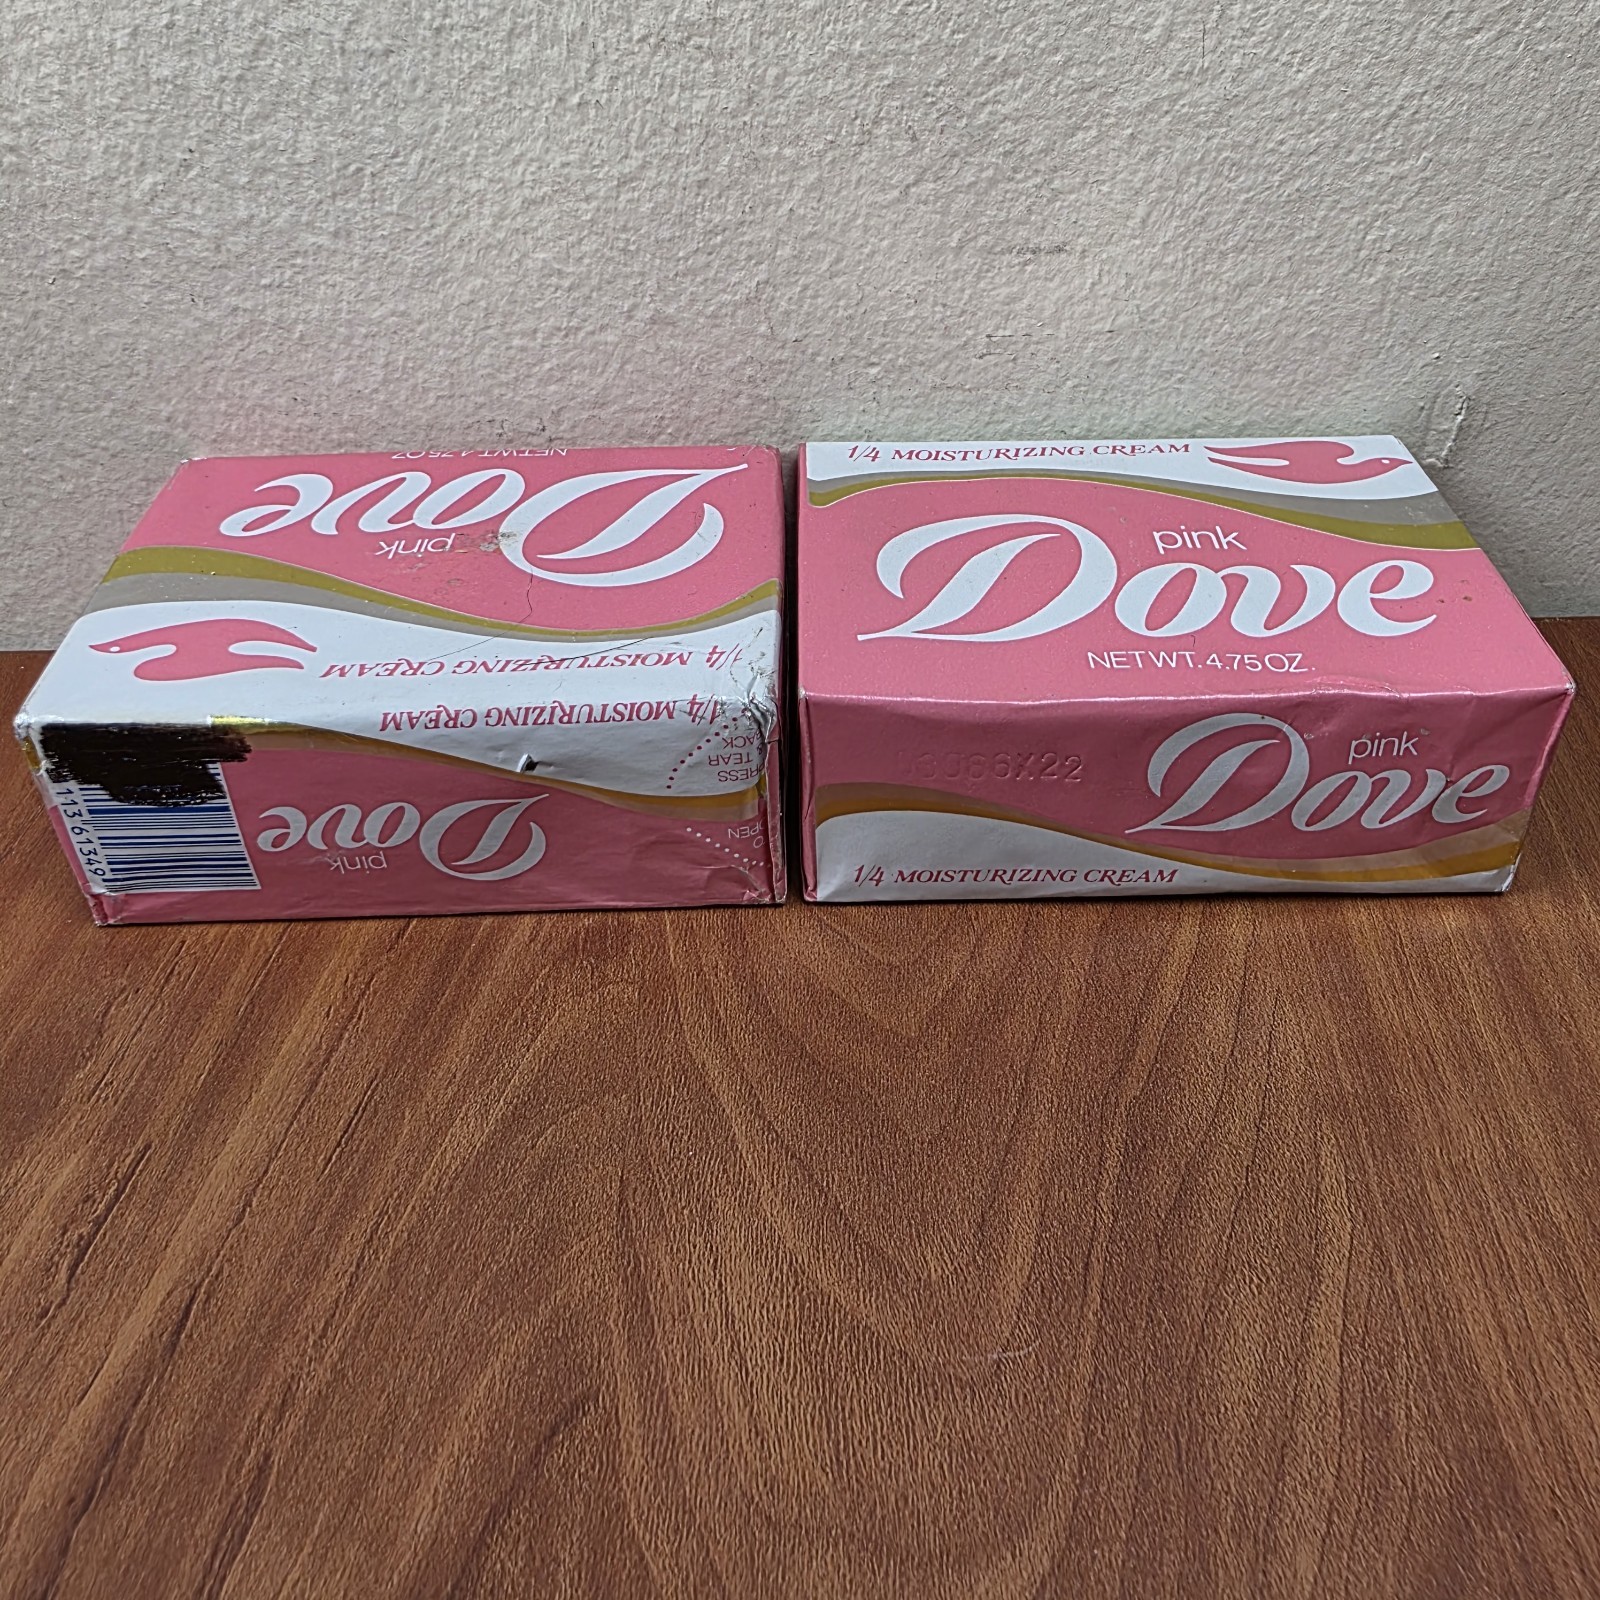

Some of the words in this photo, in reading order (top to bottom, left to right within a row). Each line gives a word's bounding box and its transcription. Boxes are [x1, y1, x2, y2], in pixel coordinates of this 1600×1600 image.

[848, 444, 881, 462] 1/4
[891, 445, 1084, 462] MOISTURIZING
[1093, 443, 1191, 458] CREAM
[219, 463, 748, 587] Dove
[375, 533, 457, 559] pink
[1153, 525, 1247, 555] pink
[857, 513, 1438, 643] Dove
[318, 657, 445, 679] CREAM
[452, 650, 694, 675] MOISTURIZING
[706, 643, 743, 671] 1/4
[379, 704, 478, 732] CREAM
[484, 700, 679, 729] MOISTURIZING
[685, 693, 721, 726] 1/4
[708, 752, 753, 767] TEAR
[1348, 731, 1419, 764] pink
[1125, 712, 1510, 834] Dove
[257, 793, 549, 881] Dove
[329, 851, 388, 875] pink
[854, 864, 885, 887] 1/4
[894, 868, 1077, 886] MOISTURIZING
[1083, 868, 1179, 887] CREAM
